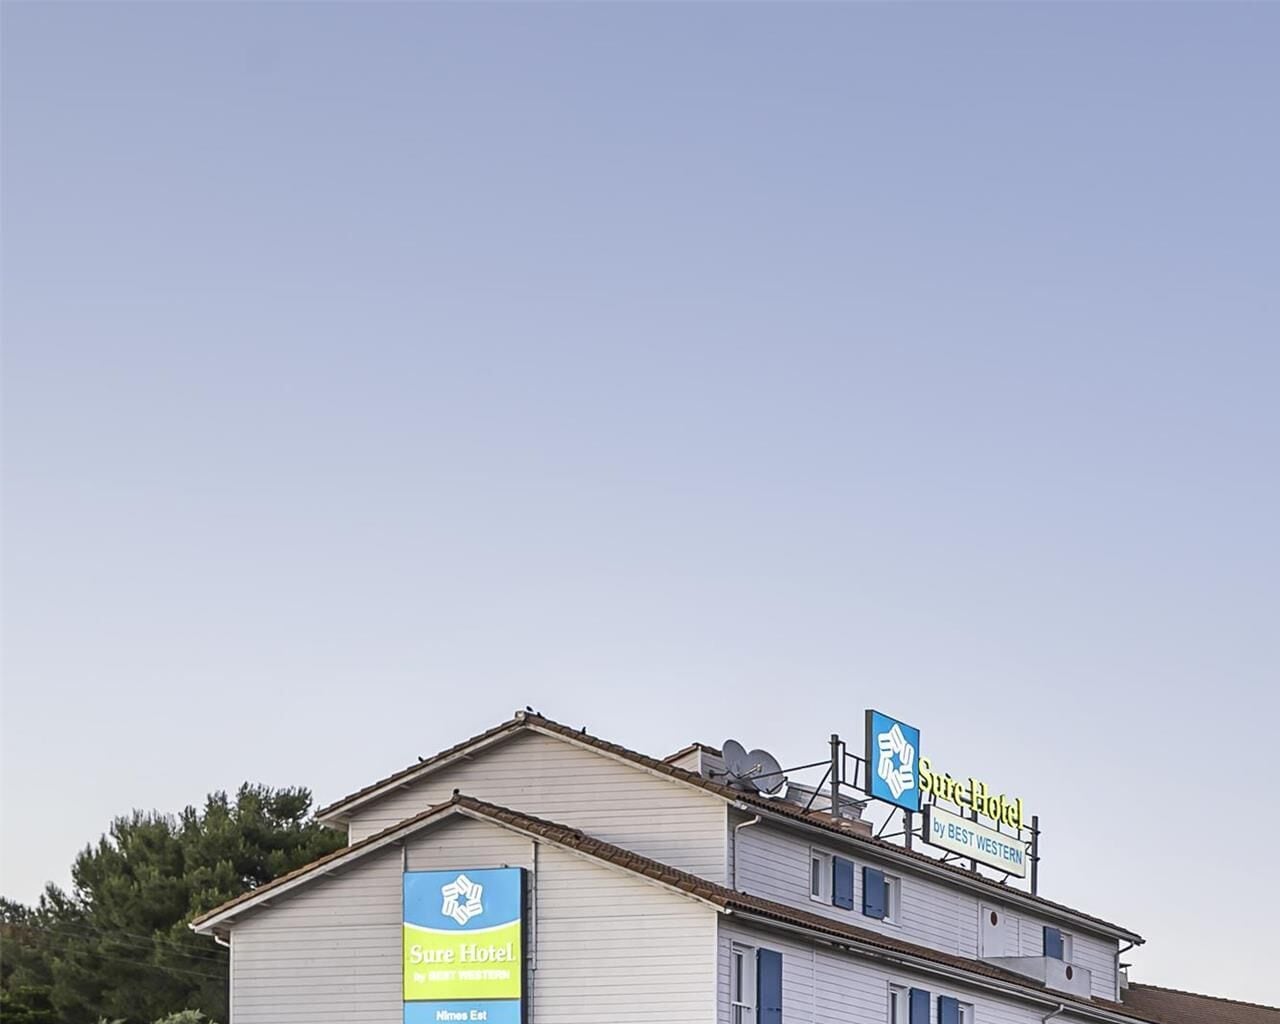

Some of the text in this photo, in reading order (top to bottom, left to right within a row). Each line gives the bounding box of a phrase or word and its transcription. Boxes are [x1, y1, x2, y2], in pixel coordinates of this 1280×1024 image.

[918, 757, 1024, 830] Sure Hotel
[933, 817, 1023, 864] by BEST WESTERN
[410, 942, 513, 965] Sure Hotel
